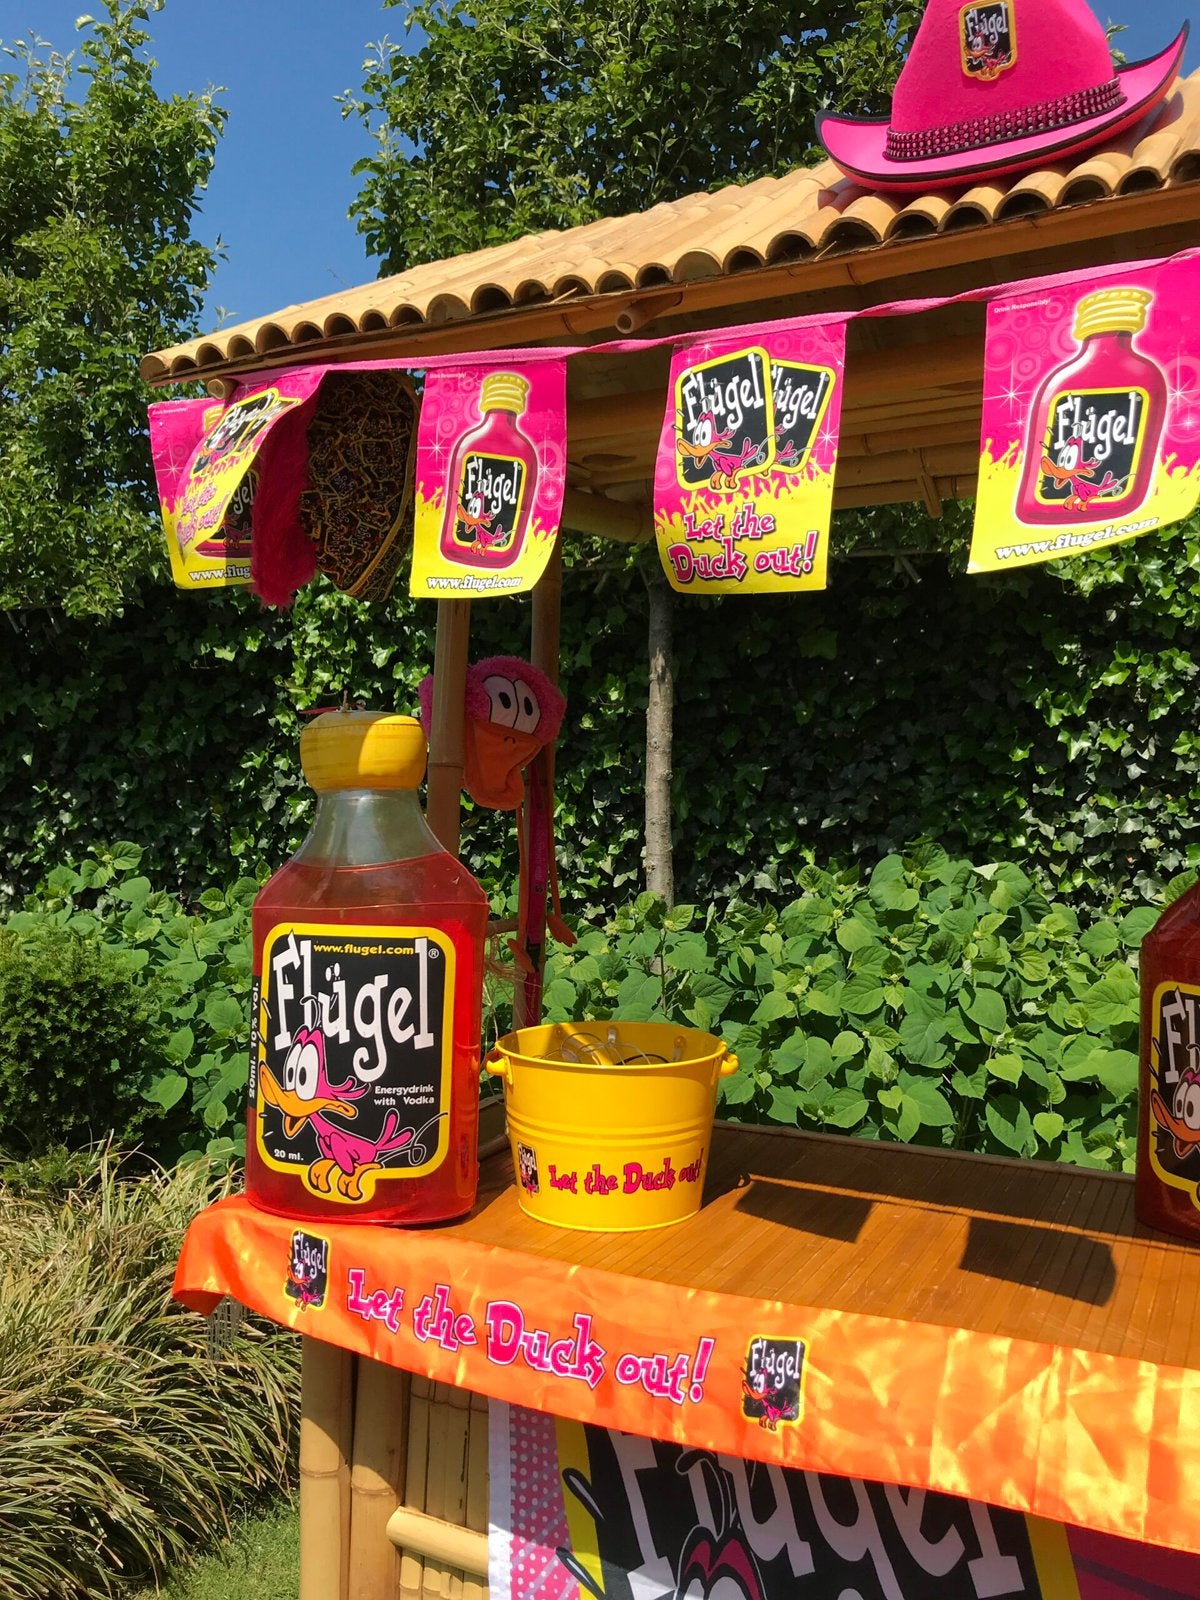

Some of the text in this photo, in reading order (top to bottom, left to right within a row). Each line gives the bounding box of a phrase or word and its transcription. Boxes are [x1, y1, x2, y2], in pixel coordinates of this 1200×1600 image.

[965, 2, 1009, 44] Flügel
[682, 352, 765, 430] Flügel
[1053, 391, 1137, 461] Flügel
[465, 455, 518, 514] Flügel
[683, 502, 776, 540] Let the
[994, 517, 1159, 561] www.flugel.com
[189, 565, 252, 581] www.flug
[668, 530, 819, 582] Duck out!
[426, 574, 522, 592] www.flugel.com
[313, 943, 414, 956] www.flugel.com
[272, 931, 434, 1082] Flügel
[250, 1017, 258, 1048] 10%
[374, 1094, 434, 1106] with Vodka
[375, 1084, 434, 1096] Energydrink
[273, 1148, 304, 1161] 20 ml.
[548, 1165, 578, 1194] Let
[583, 1163, 618, 1195] the
[622, 1157, 676, 1194] Duck
[293, 1231, 326, 1279] Flügel
[347, 1268, 717, 1406] Let the Duck out!
[749, 1338, 801, 1389] Flügel
